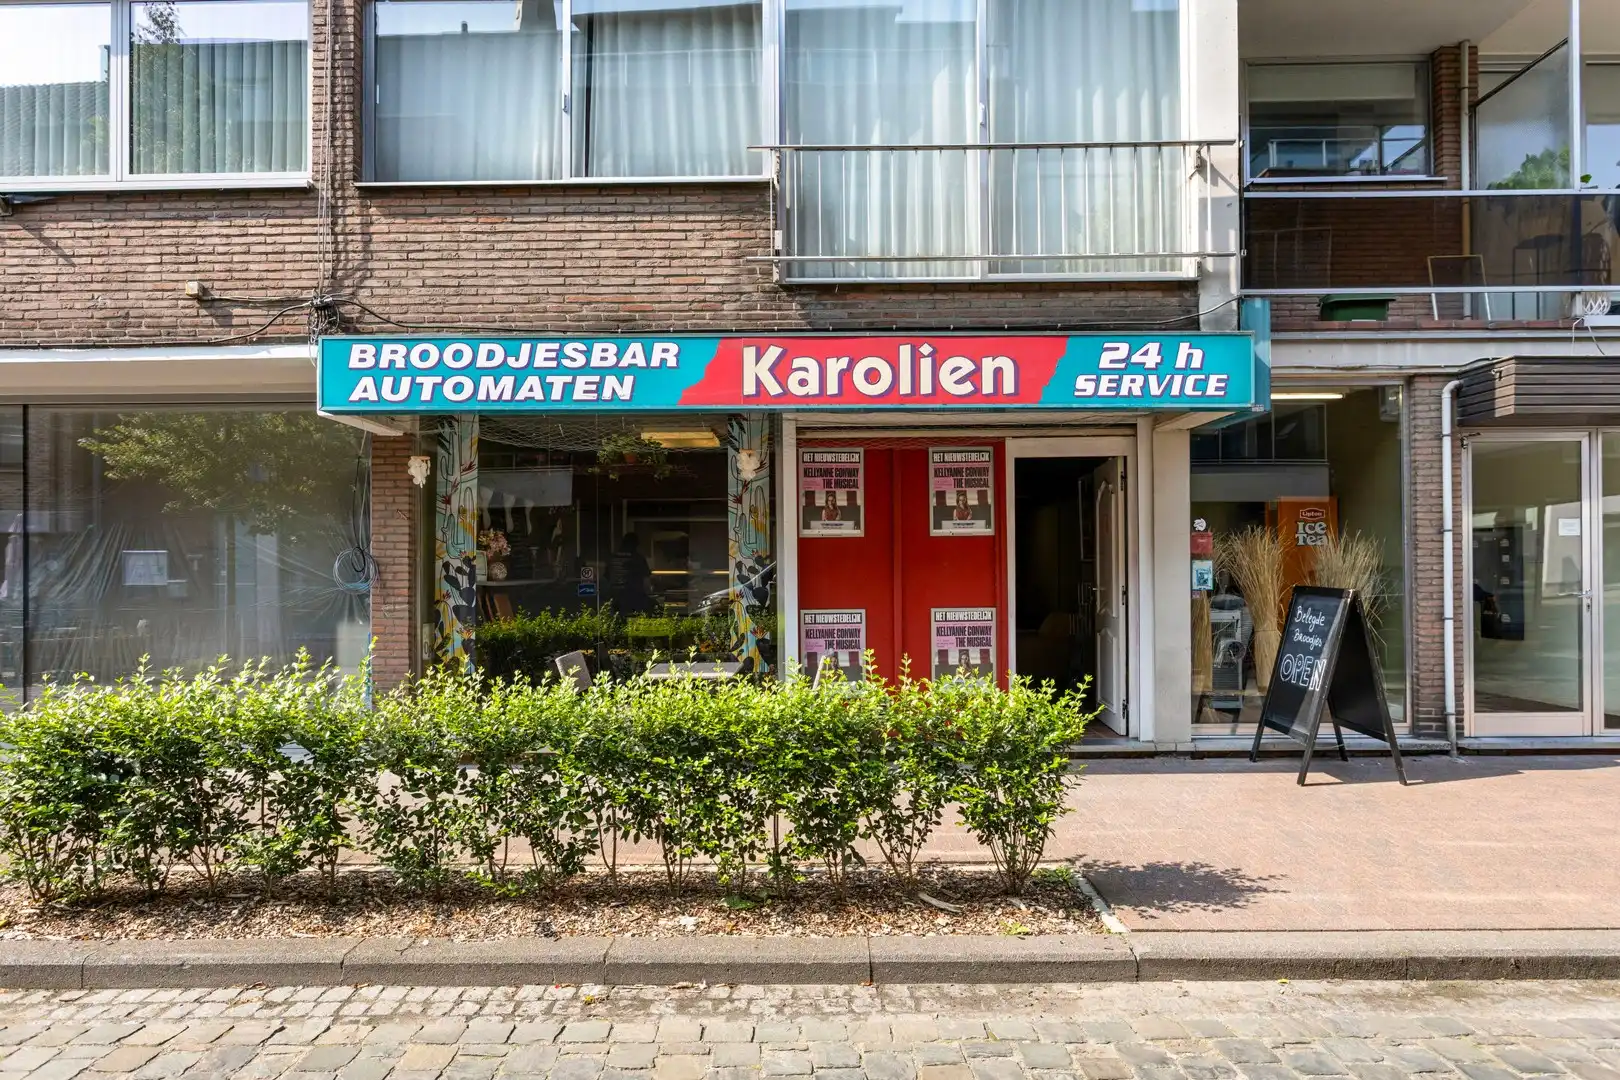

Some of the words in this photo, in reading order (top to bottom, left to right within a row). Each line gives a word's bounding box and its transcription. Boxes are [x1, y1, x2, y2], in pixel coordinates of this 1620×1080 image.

[348, 342, 680, 370] BROODJESBAR
[1098, 342, 1163, 370] 24
[1174, 342, 1206, 370] h
[742, 342, 1019, 397] Karolien
[348, 375, 635, 402] AUTOMATEN
[1073, 374, 1229, 398] SERVICE
[803, 452, 813, 462] HET
[933, 452, 943, 462] HET
[803, 467, 834, 478] KELLYANNE
[834, 467, 859, 478] CONWAY
[933, 467, 964, 478] KELLYANNE
[965, 466, 989, 478] CONWAY
[822, 478, 833, 489] THE
[833, 478, 859, 489] MUSICAL
[953, 478, 963, 488] THE
[964, 478, 989, 488] MUSICAL
[1297, 521, 1327, 534] Ice
[1295, 533, 1329, 546] Tea
[804, 614, 815, 624] HET
[935, 611, 946, 621] HET
[1295, 605, 1325, 632] Belegde
[805, 628, 836, 639] KELLYANNE
[836, 628, 861, 639] CONWAY
[936, 626, 967, 637] KELLYANNE
[967, 625, 992, 636] CONWAY
[824, 640, 835, 650] THE
[835, 639, 861, 650] MUSICAL
[955, 637, 966, 648] THE
[966, 637, 992, 648] MUSICAL
[1293, 628, 1323, 651] Broodjes
[1280, 653, 1327, 691] OPEN
